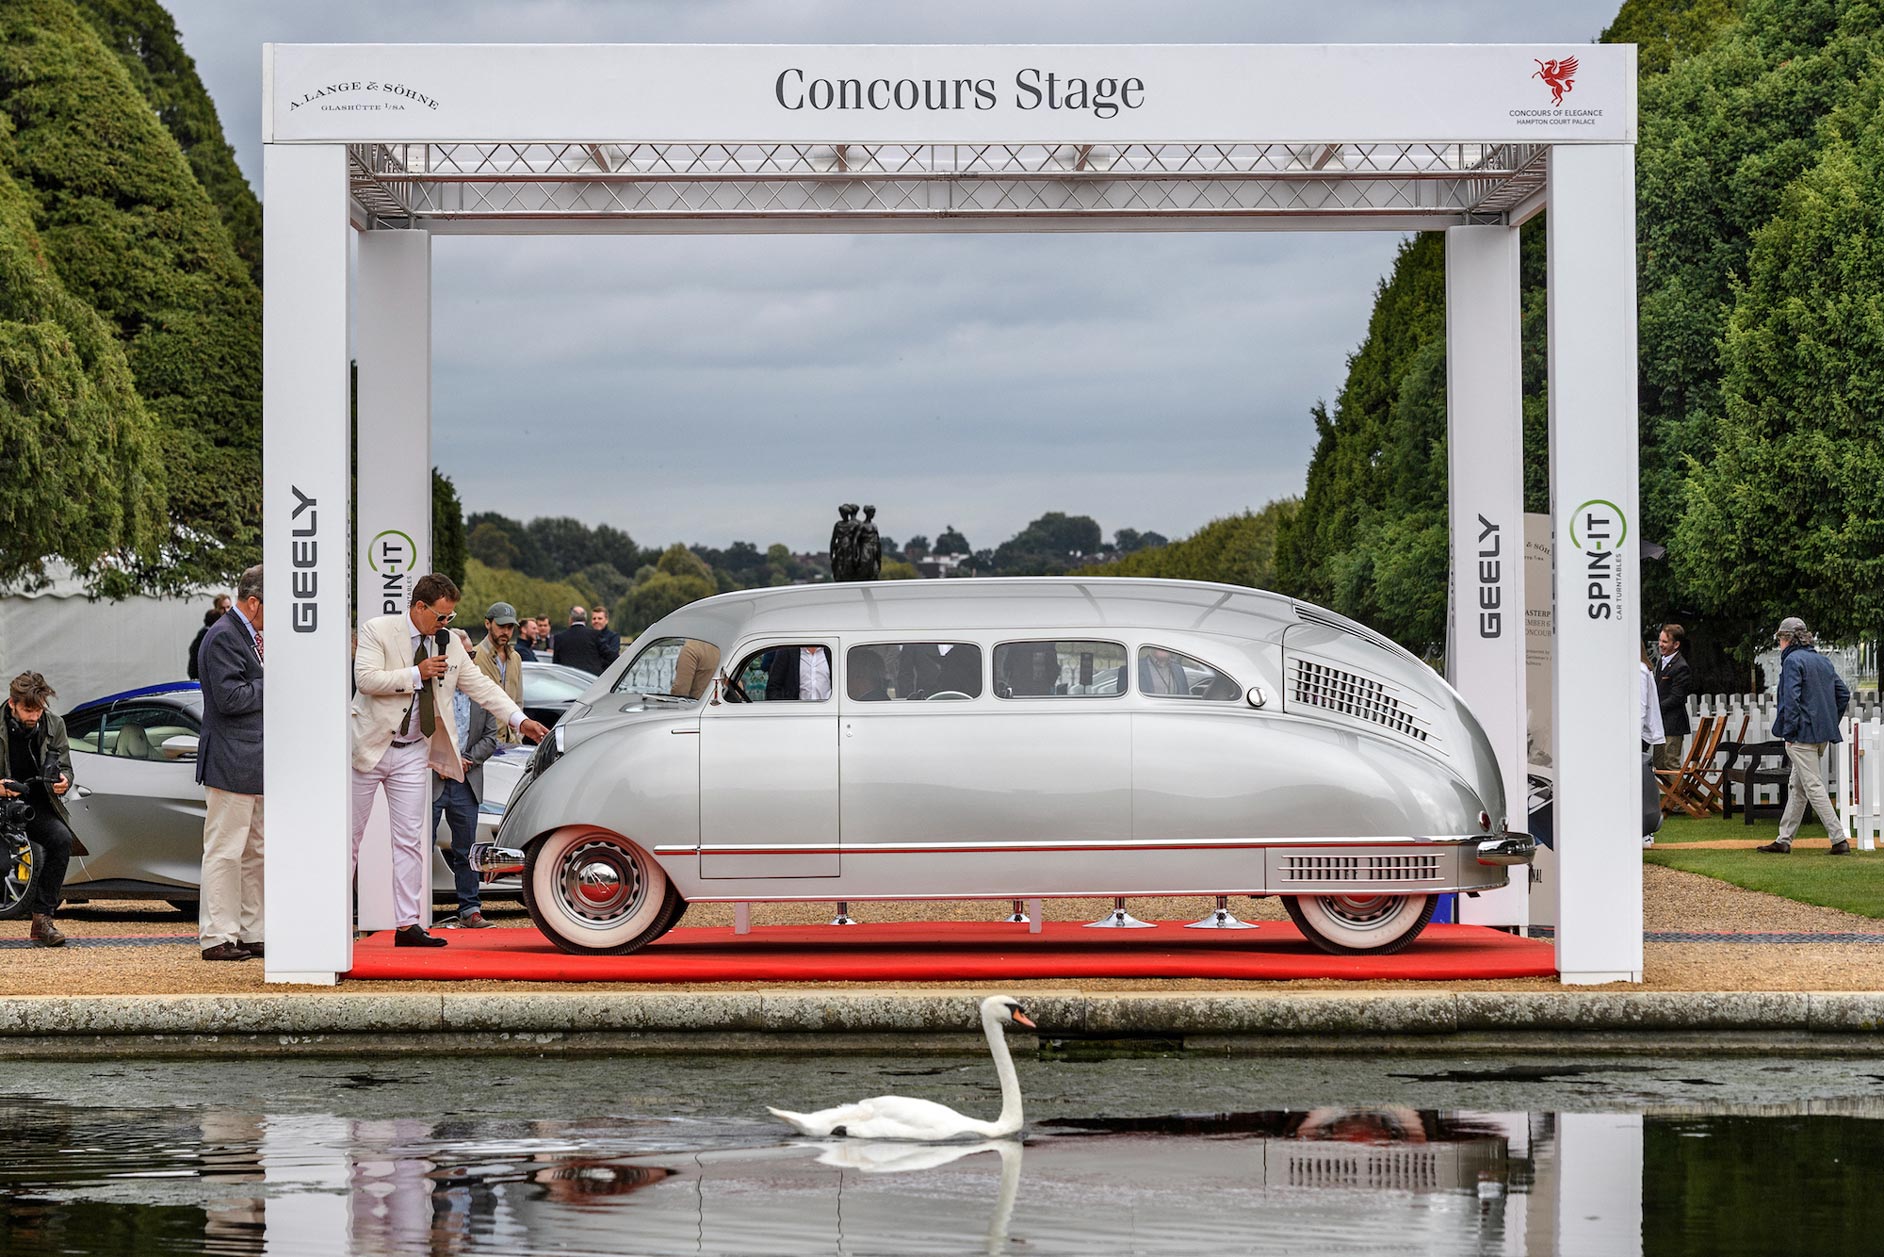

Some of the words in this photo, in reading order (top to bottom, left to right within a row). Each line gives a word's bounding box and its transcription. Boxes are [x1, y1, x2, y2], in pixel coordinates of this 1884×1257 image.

[321, 103, 381, 111] GLASHÜTTE
[366, 81, 378, 91] &
[383, 83, 440, 111] SÖHNE
[775, 68, 997, 110] Concours
[1015, 68, 1145, 119] Stage
[1509, 109, 1552, 117] CONCOURS
[1553, 109, 1563, 117] OF
[1564, 109, 1603, 117] ELEGANCE
[292, 484, 318, 633] GEELY
[1478, 513, 1502, 638] GEELY
[1586, 513, 1612, 620] SPIN-IT
[1615, 553, 1623, 602] TURNTABLES
